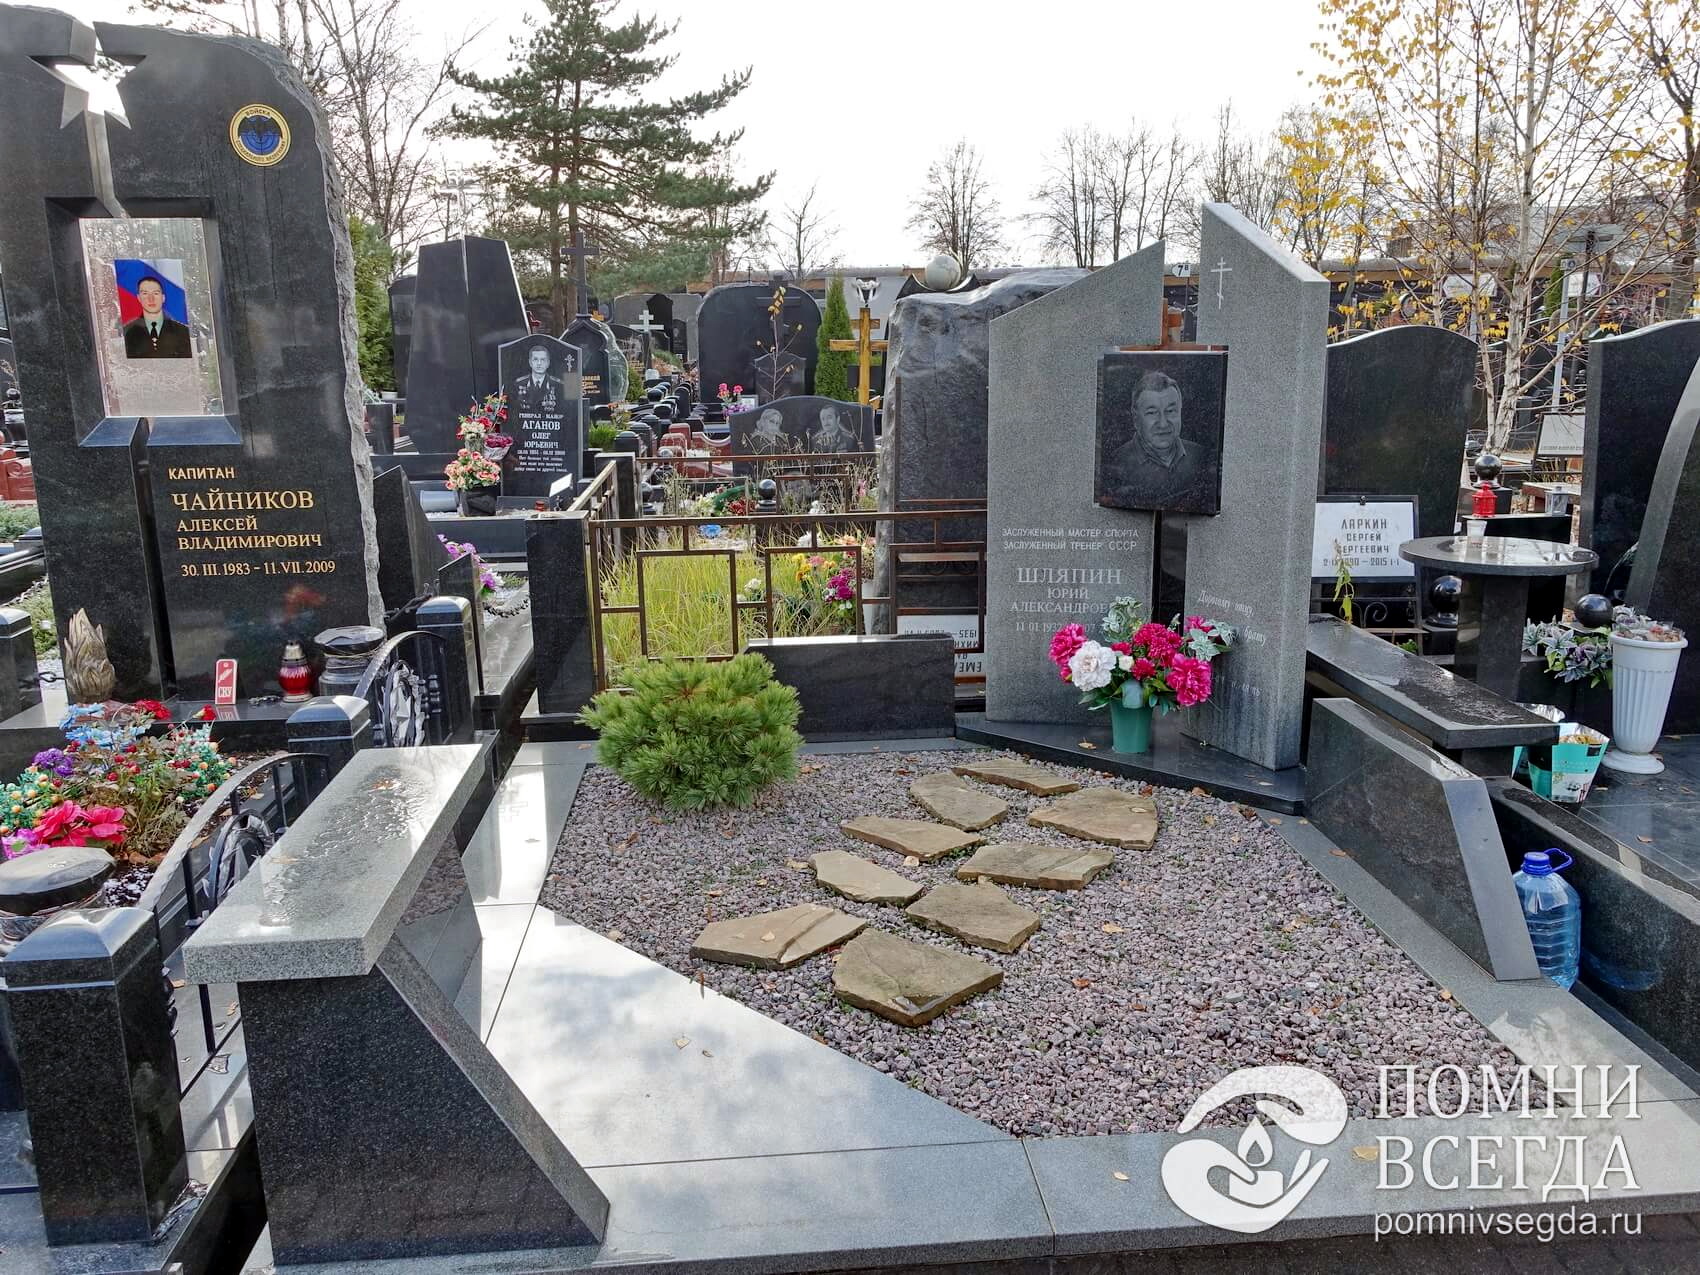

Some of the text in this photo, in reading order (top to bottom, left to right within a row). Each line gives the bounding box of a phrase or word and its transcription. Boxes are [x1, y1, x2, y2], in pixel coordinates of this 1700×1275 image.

[522, 420, 561, 430] АГАНОВ
[531, 432, 551, 440] ОЛЕГ
[168, 467, 235, 480] КАПИТАН
[171, 488, 314, 511] ЧАЙНИКОВ
[177, 515, 258, 532] АЛЕКСЕЙ
[1341, 519, 1387, 529] ЛАРКИН
[1002, 528, 1139, 537] ЗАСЛУЖЕННЫЙ МАСТЕР СПОРТА
[178, 534, 322, 551] ВЛАДИМИРОВИЧ
[1003, 540, 1137, 551] ЗАСЛУЖЕННЫЙ ТРЕНЕР СССР
[1017, 567, 1122, 585] ШЛЯПИН
[1047, 587, 1089, 599] ЮРИЙ
[1010, 601, 1110, 614] АЛЕКСАНДРОВ
